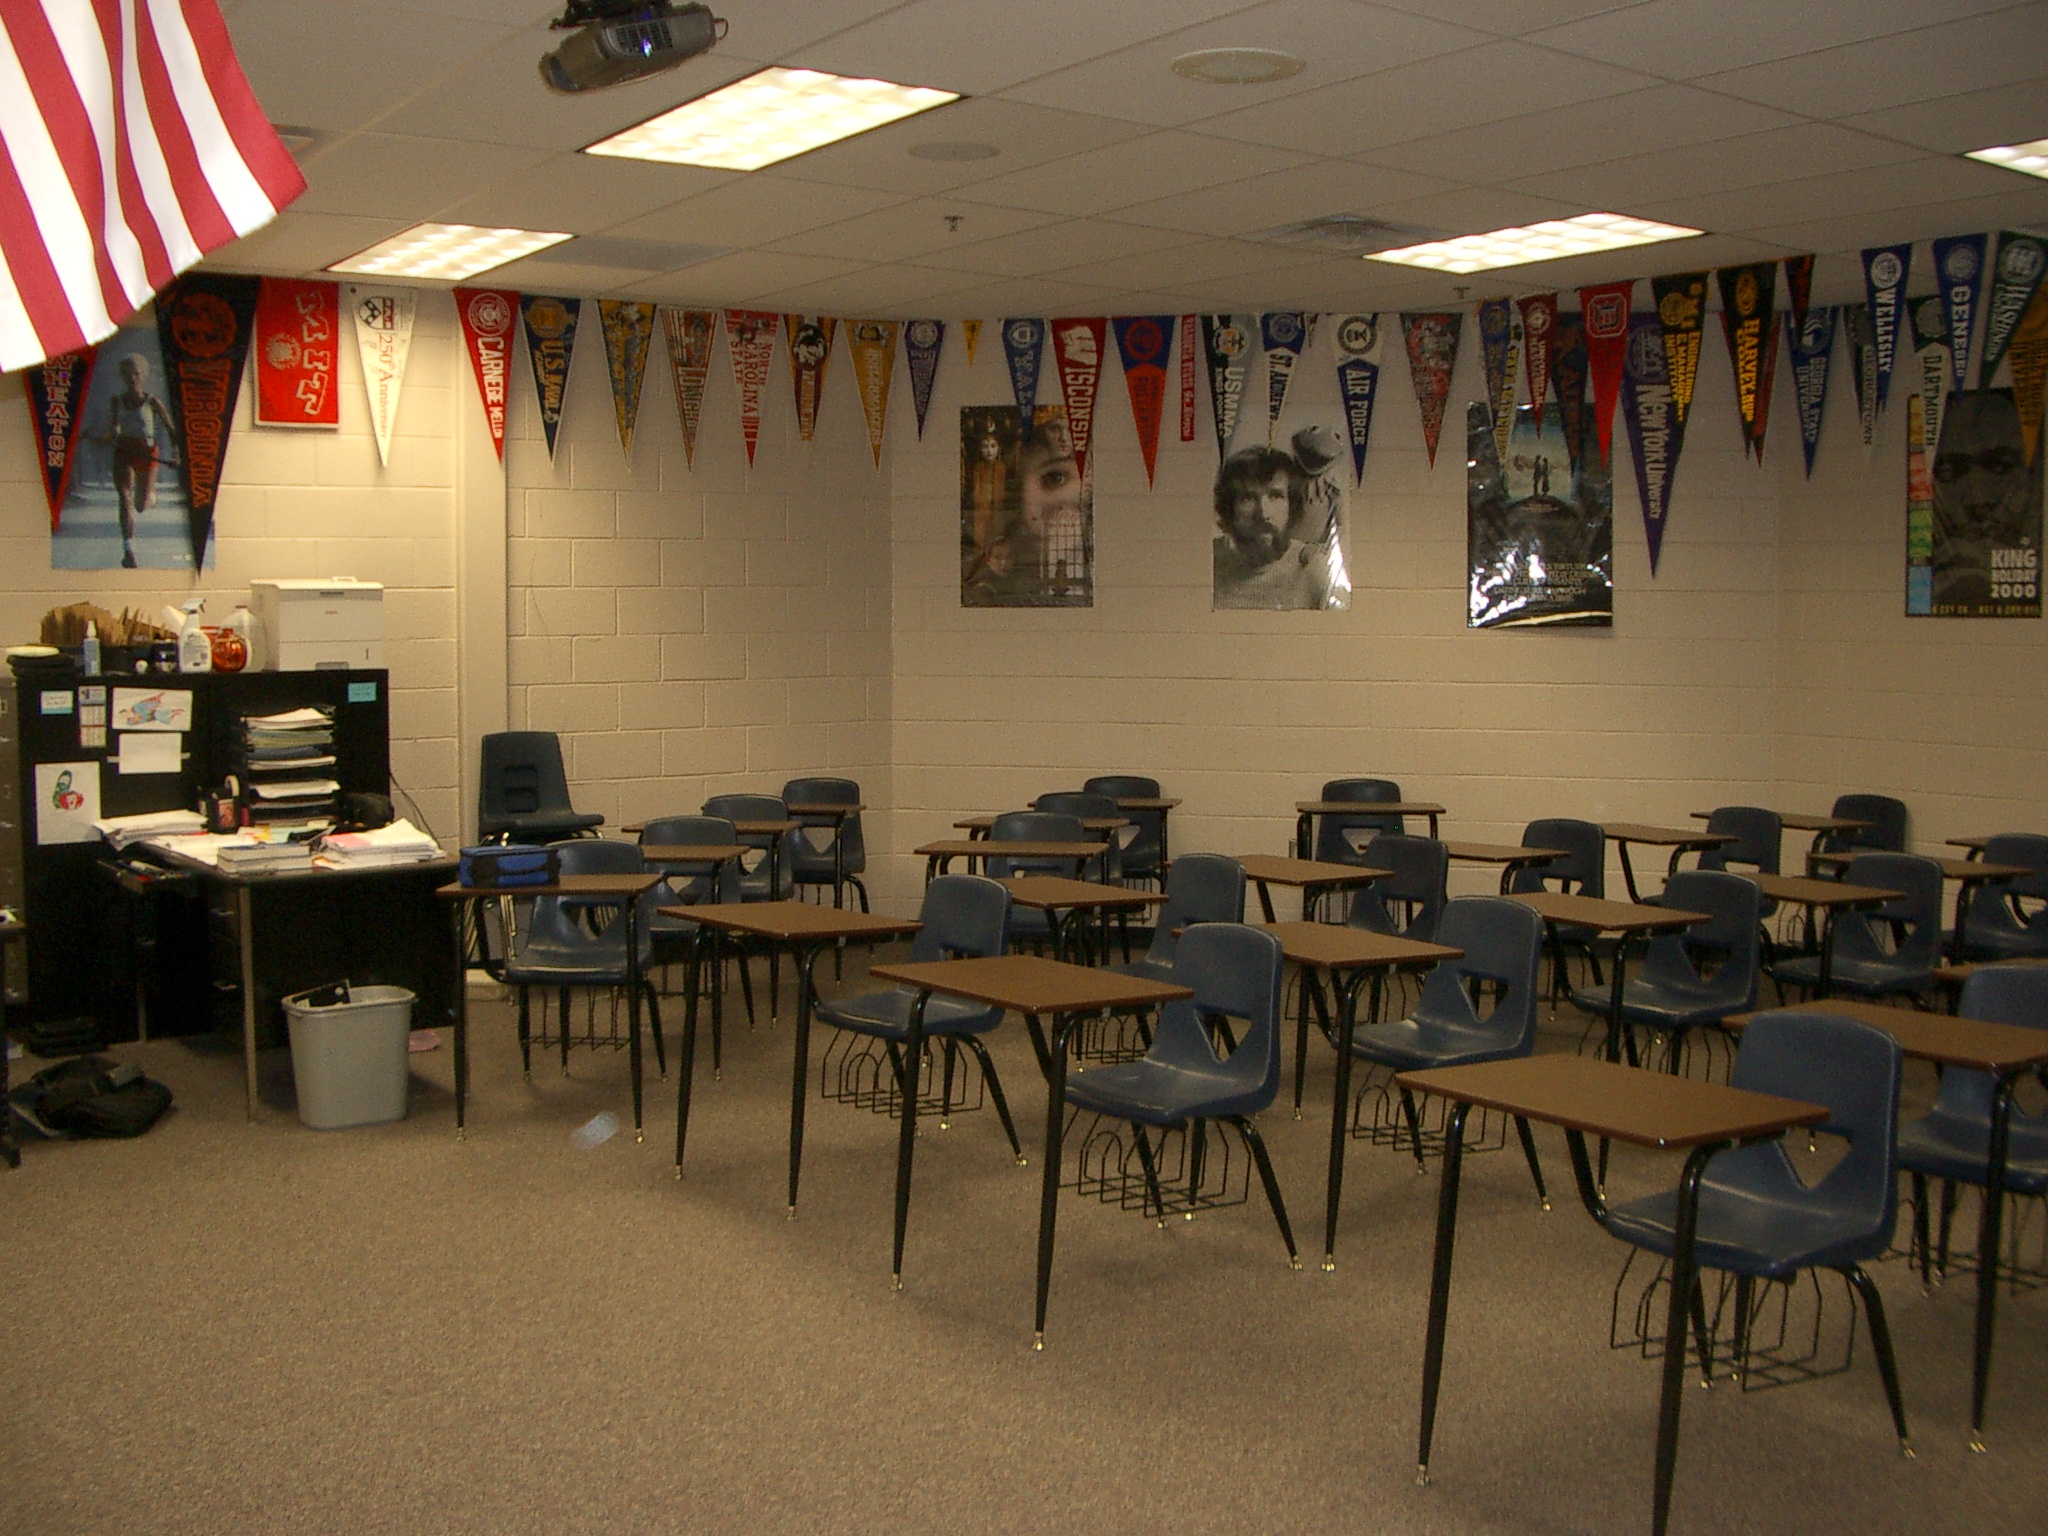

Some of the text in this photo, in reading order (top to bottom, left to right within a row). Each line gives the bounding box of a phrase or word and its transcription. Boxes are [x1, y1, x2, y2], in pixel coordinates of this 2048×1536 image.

[296, 290, 329, 415] MIT
[730, 341, 743, 384] STATE
[758, 342, 773, 386] NORTH
[1743, 318, 1761, 392] HARVEY
[1875, 286, 1897, 373] WELLESLEY
[378, 369, 394, 439] Anniversary
[743, 341, 759, 414] CAROLINA
[1014, 350, 1035, 418] YALE
[1222, 366, 1245, 439] USMMA
[1345, 369, 1372, 446] AIR FORCE
[1924, 355, 1943, 446] DARTMOUTH
[178, 359, 232, 508] VIRGINIA
[1991, 549, 2037, 568] KING
[1991, 569, 2037, 582] HOLIDAY
[1991, 584, 2037, 598] 2000
